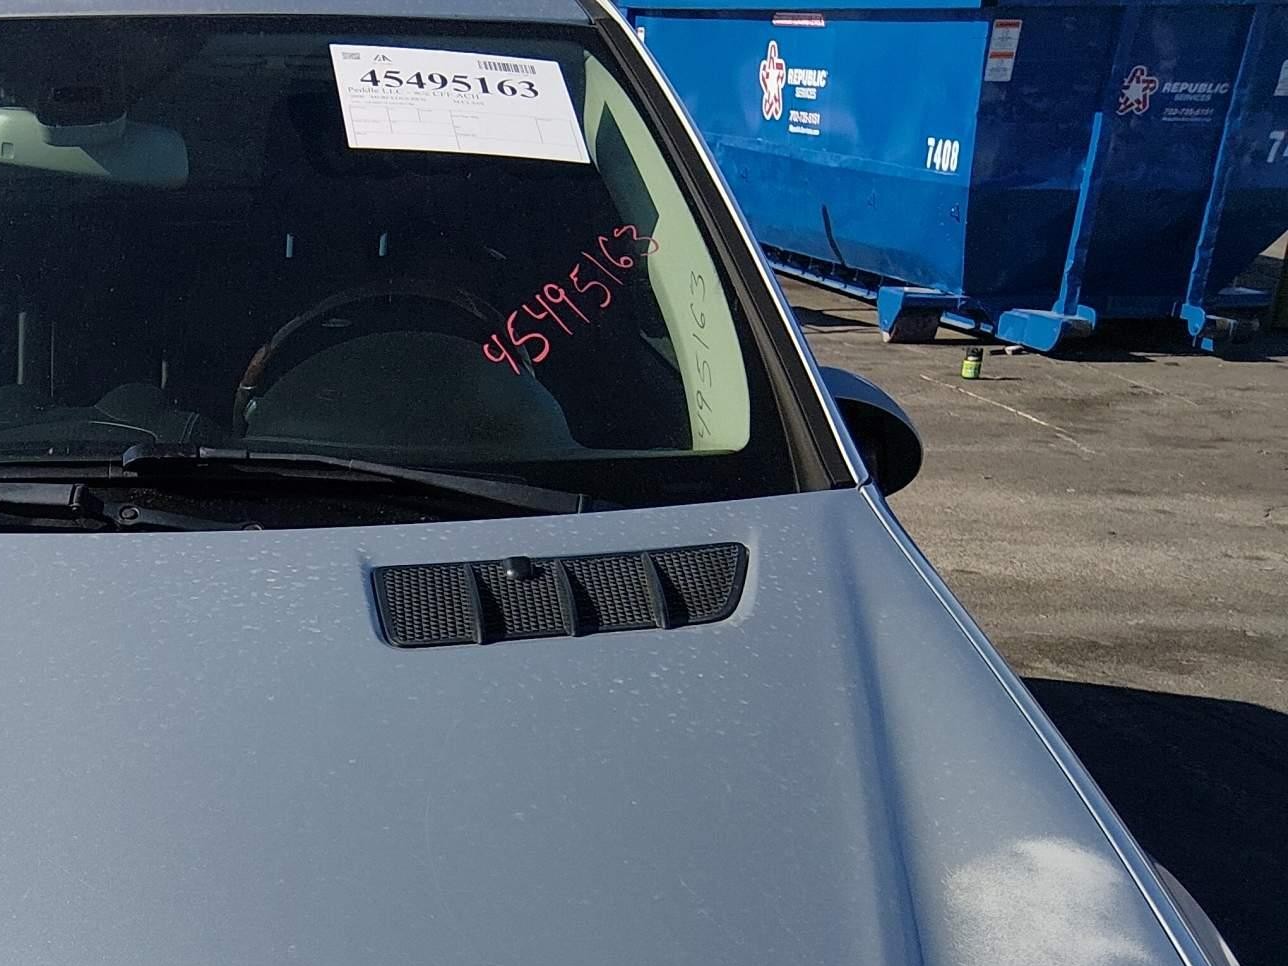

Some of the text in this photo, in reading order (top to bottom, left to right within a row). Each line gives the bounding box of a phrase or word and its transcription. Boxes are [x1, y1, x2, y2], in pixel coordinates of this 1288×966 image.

[360, 69, 539, 98] 45495163
[788, 68, 826, 87] REPUBLIC
[1162, 82, 1230, 94] REPUBLIC
[926, 137, 960, 171] 7408
